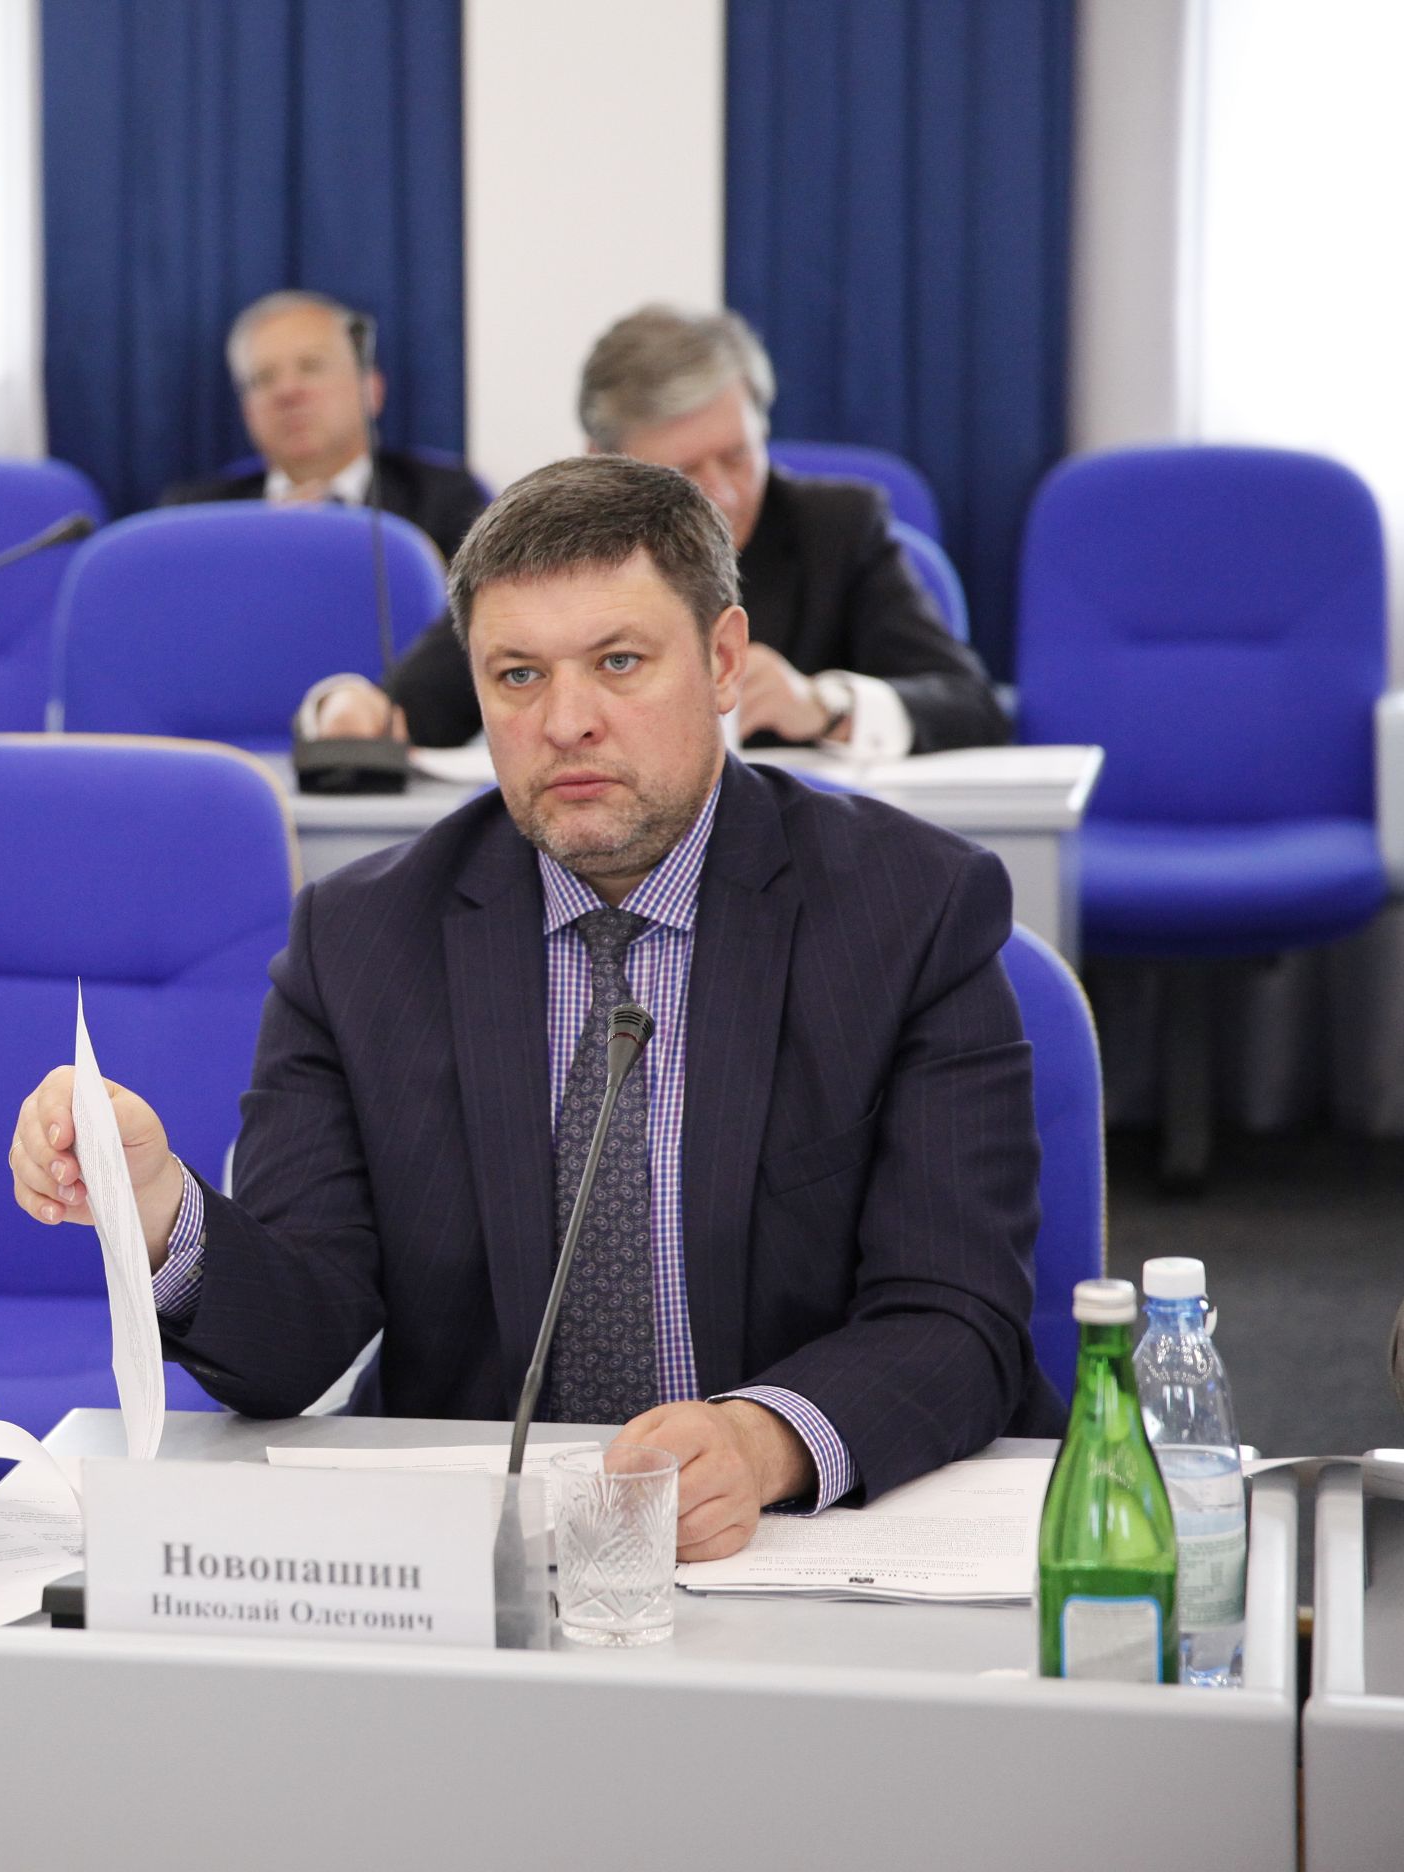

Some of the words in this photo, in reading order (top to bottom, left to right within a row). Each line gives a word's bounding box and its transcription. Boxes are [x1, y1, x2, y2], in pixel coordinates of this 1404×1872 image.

[162, 1542, 421, 1590] Новопашин
[150, 1592, 280, 1623] Николай
[289, 1599, 435, 1632] Олегович
